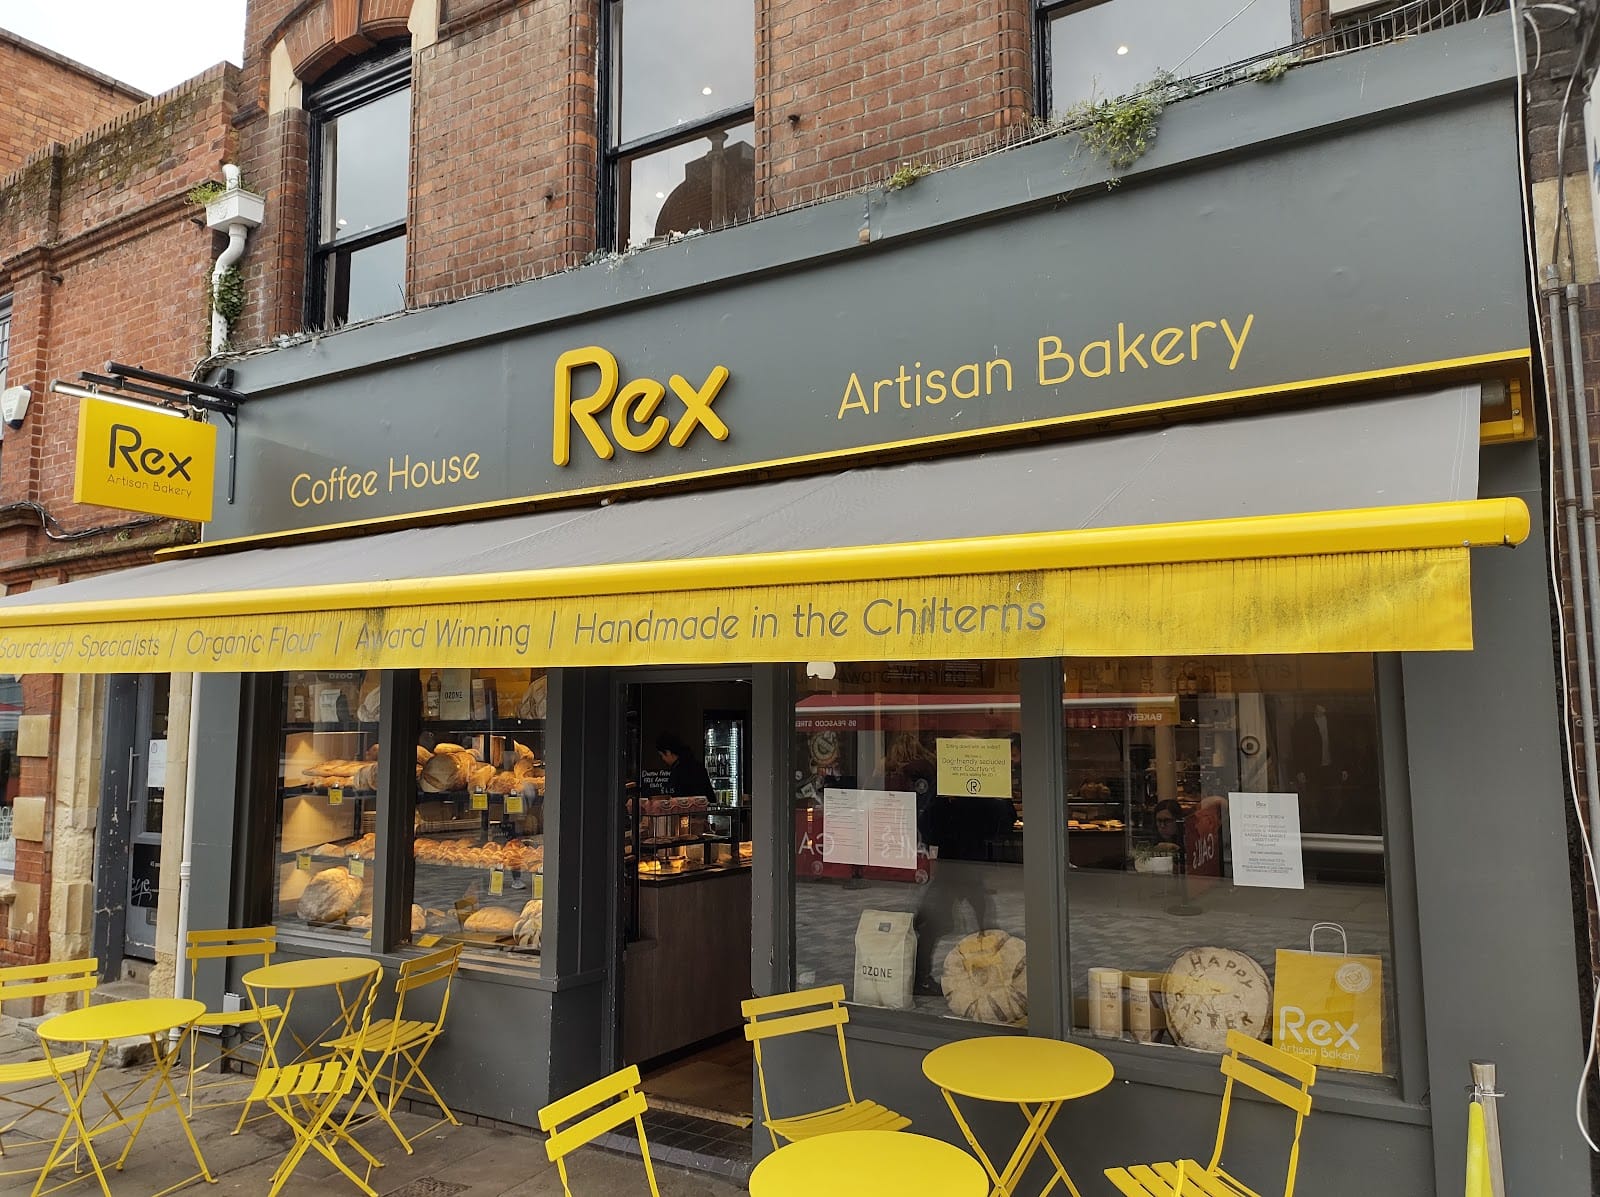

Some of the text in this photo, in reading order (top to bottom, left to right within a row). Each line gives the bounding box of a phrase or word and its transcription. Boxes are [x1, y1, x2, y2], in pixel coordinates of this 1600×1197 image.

[837, 313, 1254, 420] Artisan Bakery
[552, 345, 730, 467] Rex
[108, 423, 193, 482] Rex
[106, 473, 192, 498] Artisan Bakery
[290, 452, 480, 508] Coffee House
[0, 596, 1046, 664] Sourdough Specialists Organic Flour Award Winning Handmade in the Chilterns
[444, 690, 463, 700] OZONE
[862, 965, 893, 978] OZONE
[1189, 952, 1253, 989] HAPPY
[1279, 1005, 1360, 1051] Rex
[1280, 1042, 1360, 1062] Artisan Bakery
